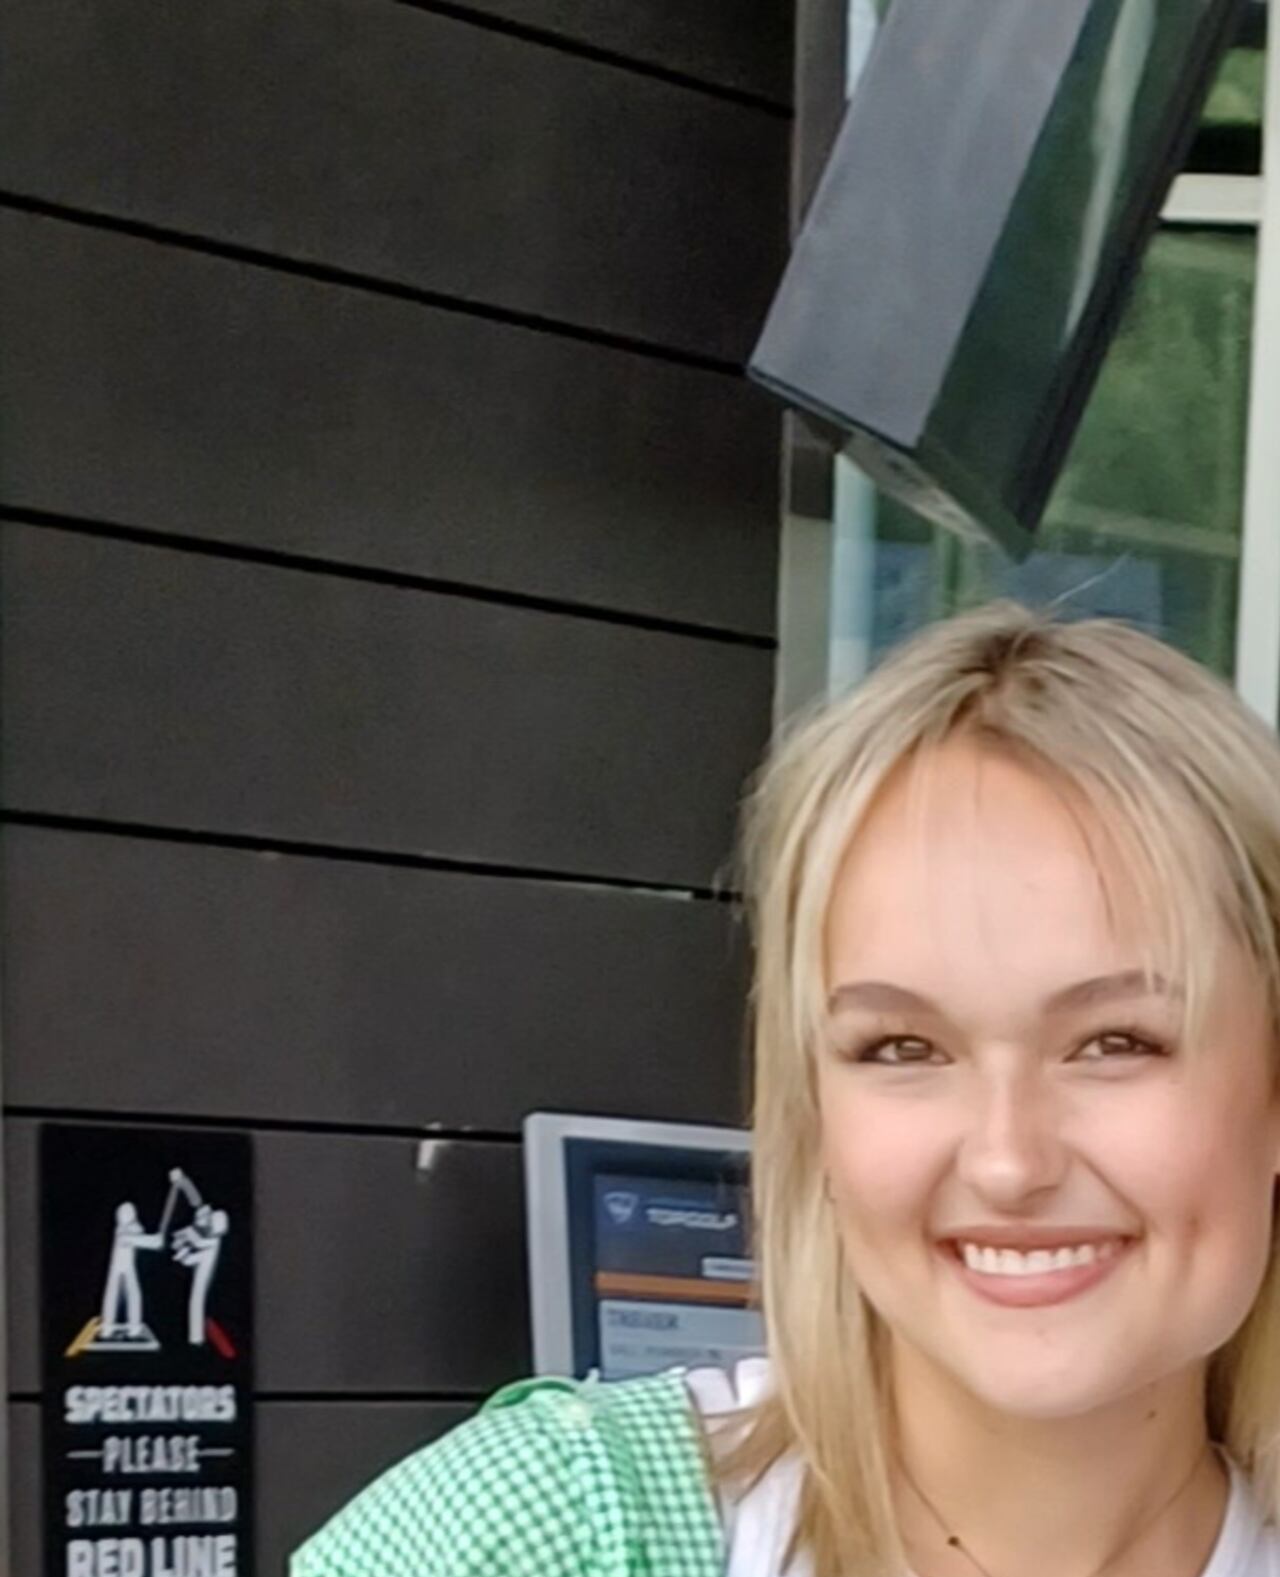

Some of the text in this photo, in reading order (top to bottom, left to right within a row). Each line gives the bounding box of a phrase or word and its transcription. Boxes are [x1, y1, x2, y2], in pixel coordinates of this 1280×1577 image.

[65, 1385, 236, 1423] SPECTATORS
[103, 1435, 200, 1473] PLEASE
[66, 1486, 237, 1527] STAY BEHIND
